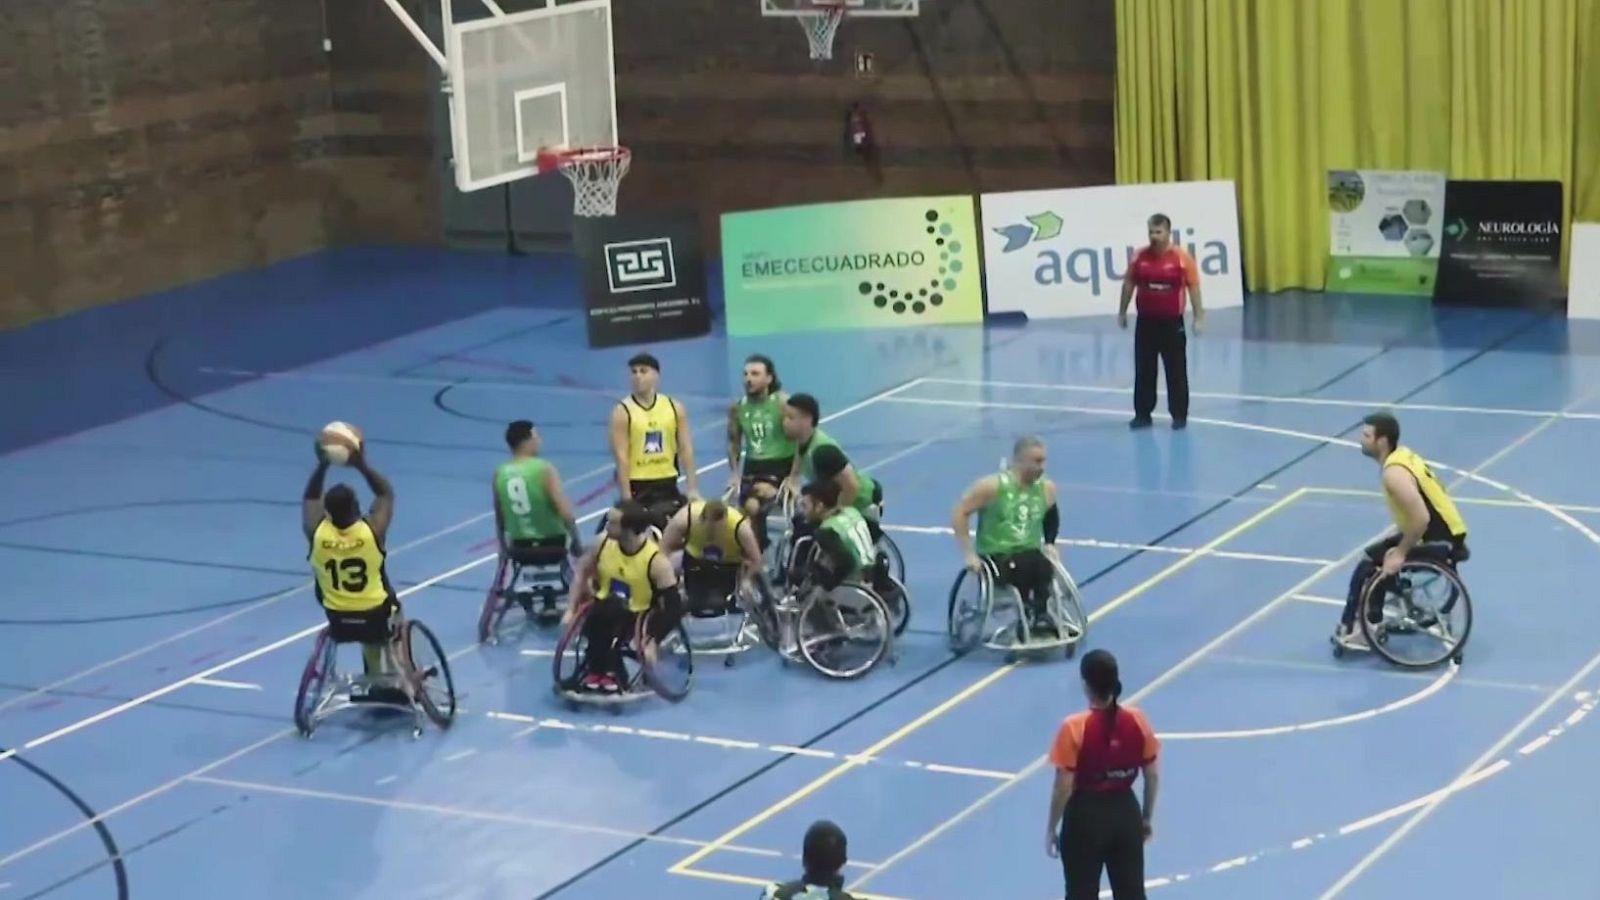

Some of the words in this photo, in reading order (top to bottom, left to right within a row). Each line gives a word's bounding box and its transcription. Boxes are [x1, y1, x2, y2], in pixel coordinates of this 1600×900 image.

[1478, 220, 1560, 235] NEUROLOGÍA
[741, 250, 926, 278] EMECECUADRADO
[1034, 228, 1229, 296] aquia
[506, 475, 531, 515] 9
[324, 557, 369, 593] 13
